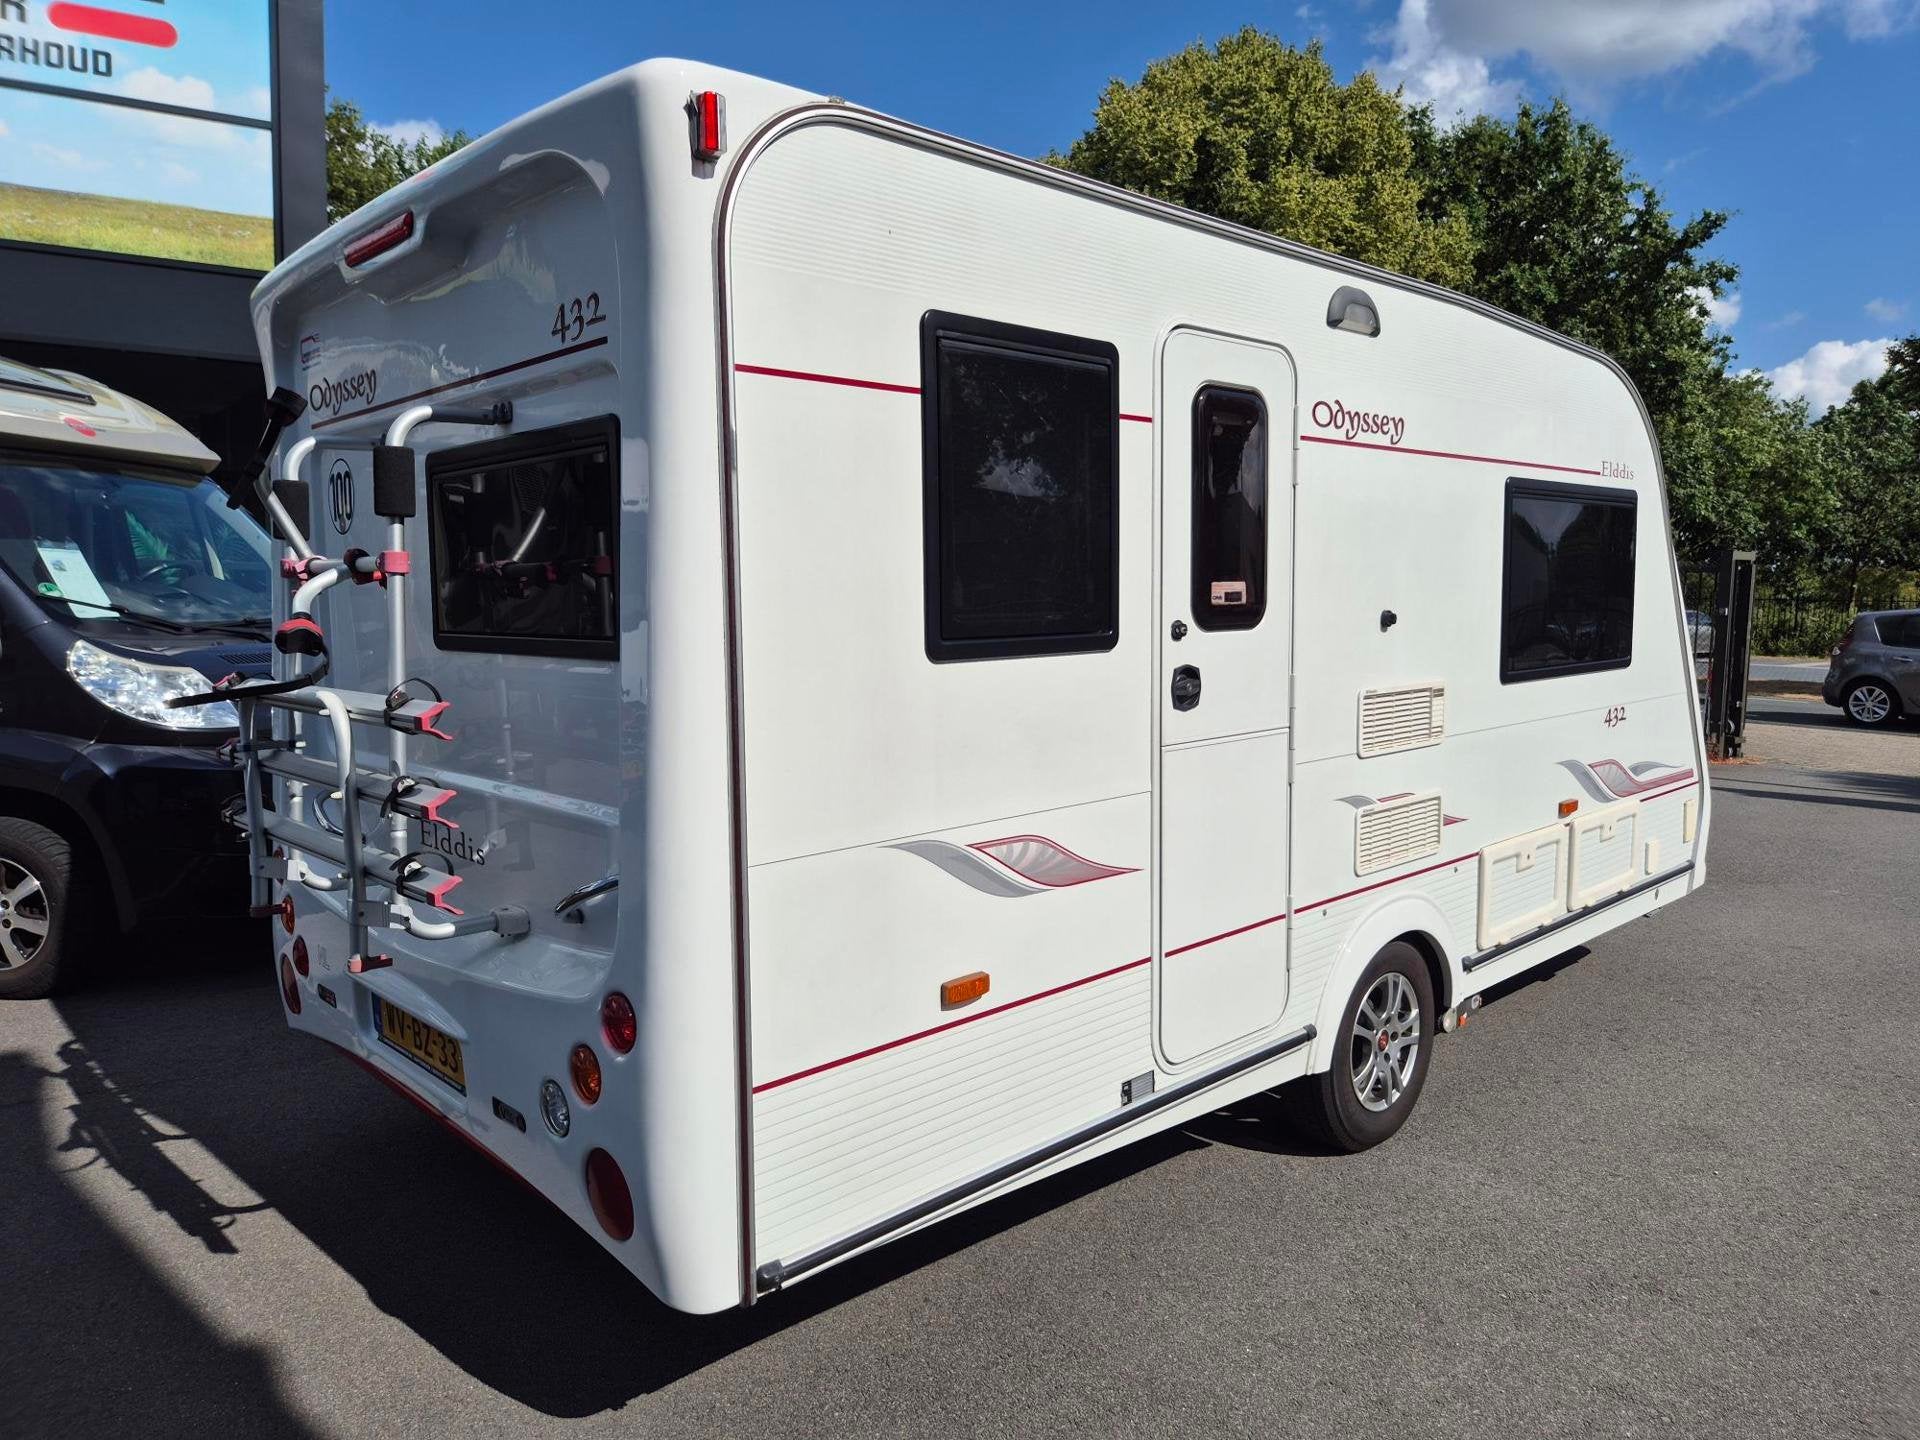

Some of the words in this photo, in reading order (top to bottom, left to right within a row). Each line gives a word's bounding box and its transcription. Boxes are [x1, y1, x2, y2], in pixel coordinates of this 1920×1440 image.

[551, 291, 607, 344] 432
[310, 369, 377, 416] Odyssey
[1312, 399, 1405, 445] Odyssey
[1601, 460, 1635, 480] Elddis
[329, 470, 353, 522] 100
[1603, 706, 1627, 728] 432
[421, 819, 486, 866] Elddis
